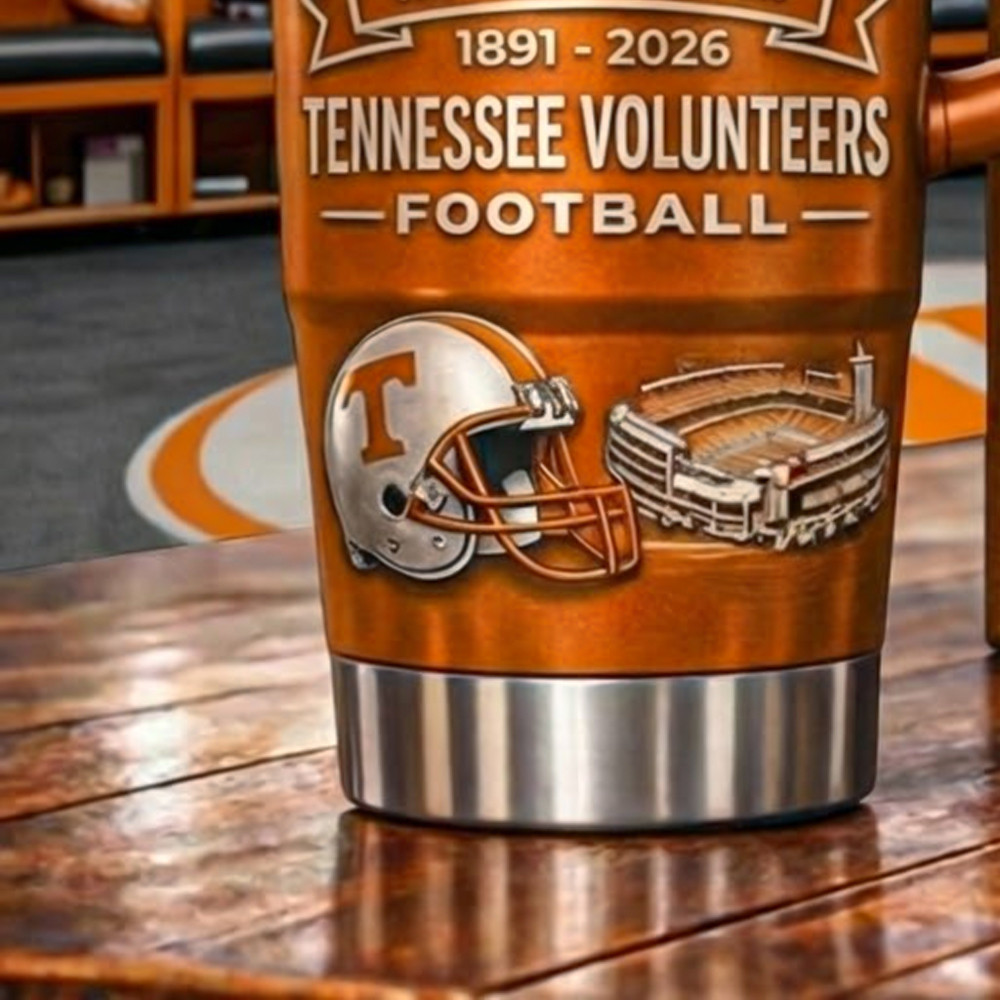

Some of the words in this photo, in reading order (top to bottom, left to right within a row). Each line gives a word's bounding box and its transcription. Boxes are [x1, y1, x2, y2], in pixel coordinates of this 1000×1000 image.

[455, 29, 557, 67] 1891
[606, 29, 731, 67] 2026
[302, 95, 566, 176] TENNESSEE
[581, 95, 890, 177] VOLUNTEERS
[396, 192, 788, 236] FOOTBALL
[341, 350, 417, 465] T
